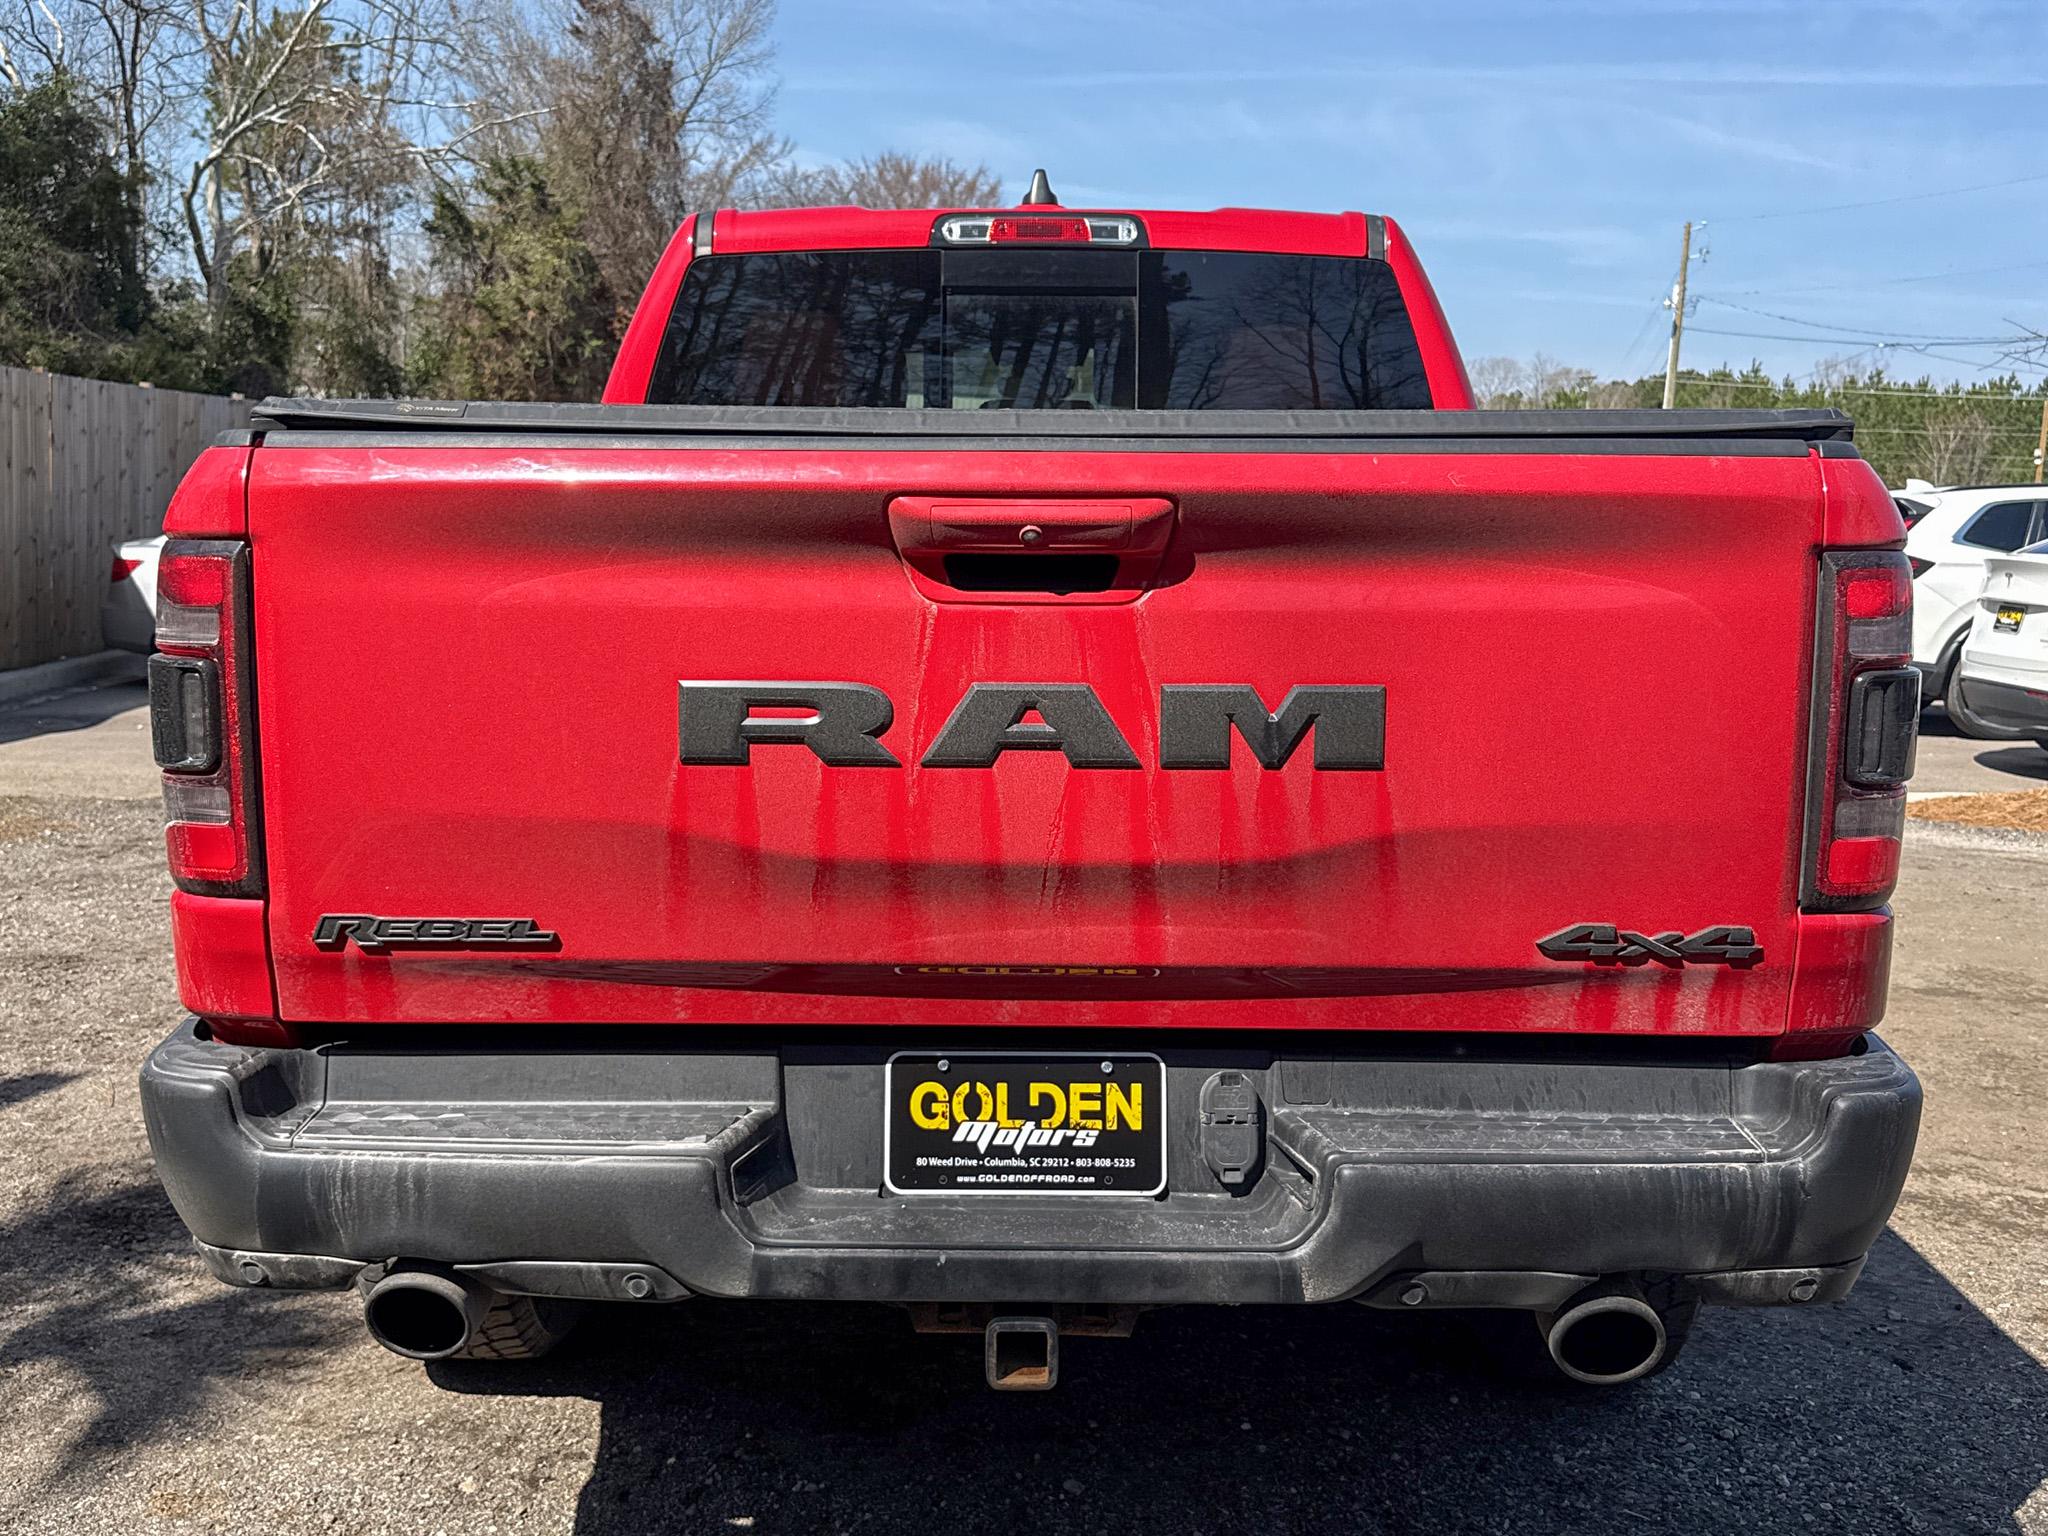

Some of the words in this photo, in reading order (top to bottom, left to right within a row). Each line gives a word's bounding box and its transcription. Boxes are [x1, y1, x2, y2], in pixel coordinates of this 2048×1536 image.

[677, 680, 1387, 769] RAM
[313, 913, 558, 948] REBEL
[1535, 922, 1765, 962] 4x4
[909, 1081, 1143, 1131] GOLDEN
[952, 1121, 1100, 1155] Motors
[916, 1157, 928, 1166] 80
[928, 1157, 953, 1166] Weed
[954, 1157, 978, 1166] Drive
[984, 1157, 1028, 1168] Columbia,
[1029, 1157, 1041, 1167] SC
[1042, 1158, 1069, 1167] 29212
[1075, 1158, 1136, 1168] 803-808-5235
